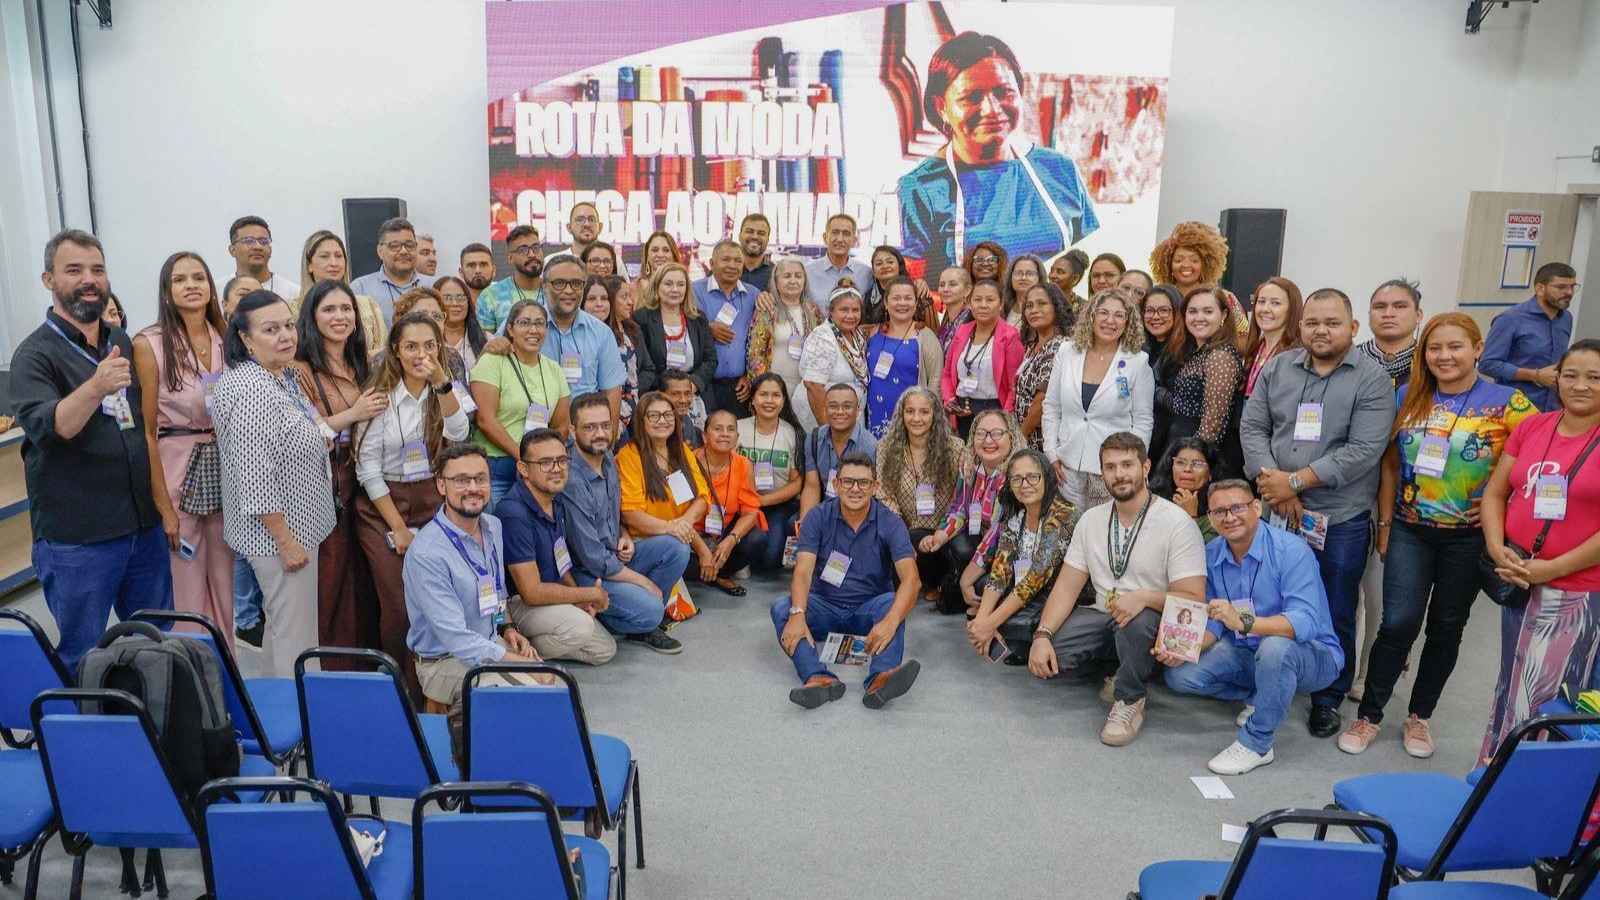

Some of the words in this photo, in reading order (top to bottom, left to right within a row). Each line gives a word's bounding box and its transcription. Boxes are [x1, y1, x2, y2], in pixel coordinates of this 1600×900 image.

[515, 100, 625, 157] ROTA
[632, 100, 694, 157] DA
[701, 101, 845, 158] MODA
[516, 189, 656, 245] CHGA
